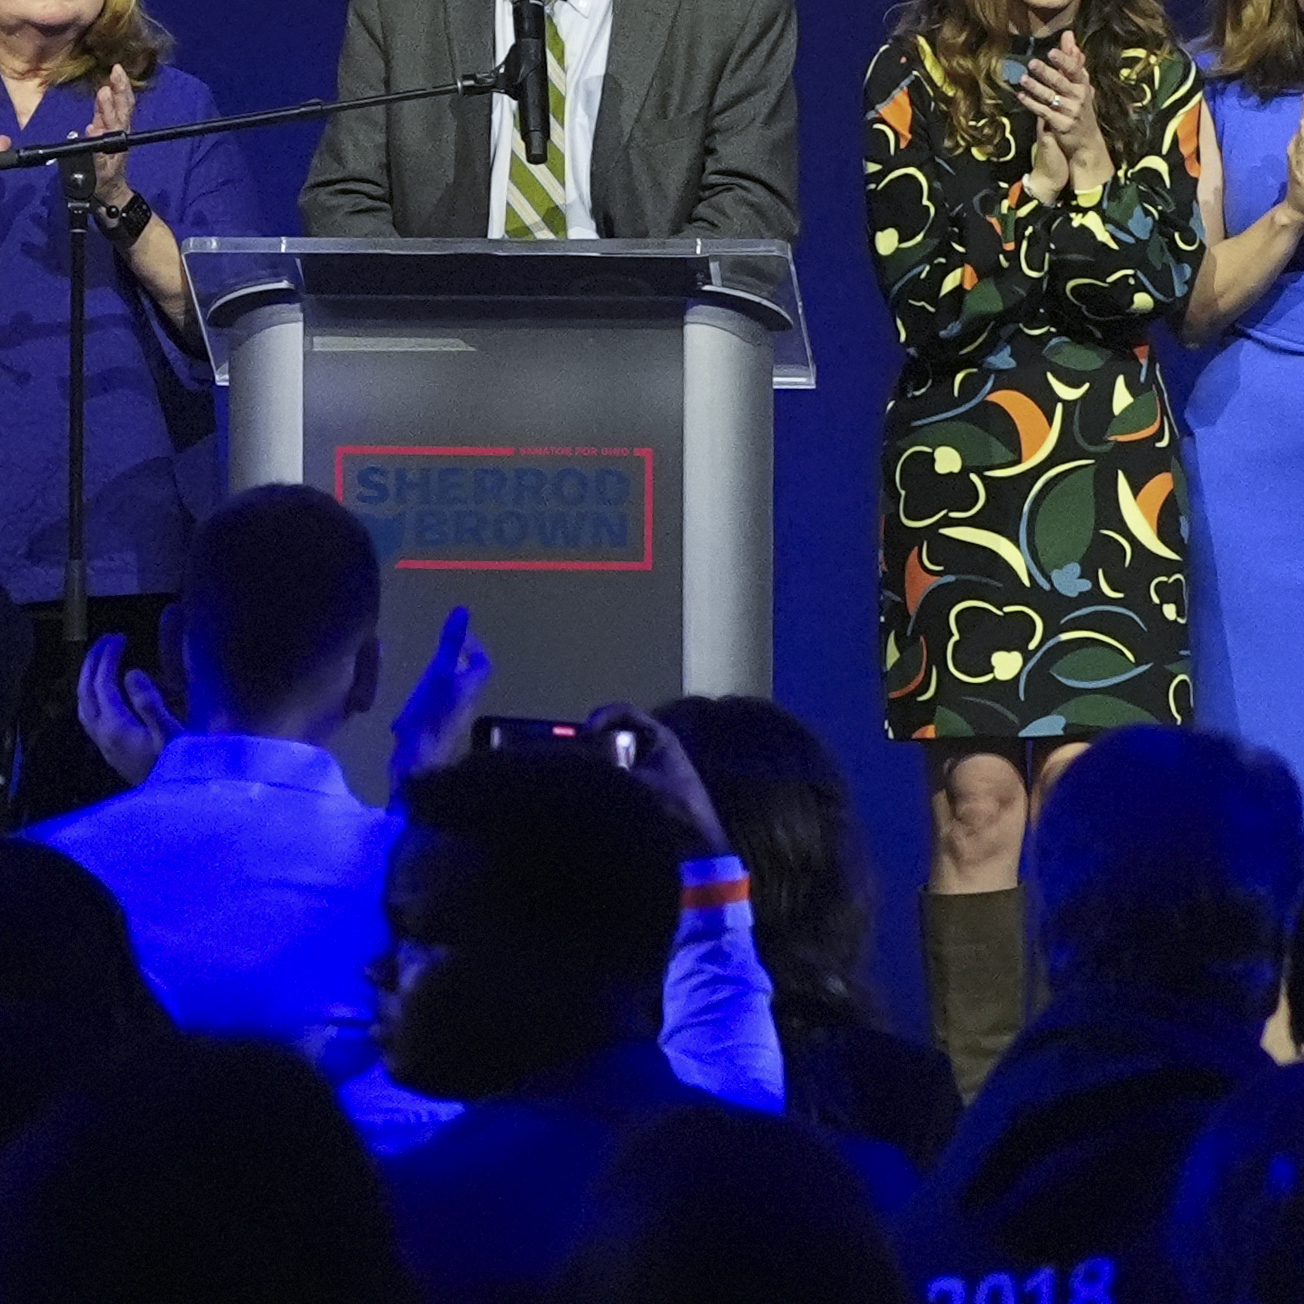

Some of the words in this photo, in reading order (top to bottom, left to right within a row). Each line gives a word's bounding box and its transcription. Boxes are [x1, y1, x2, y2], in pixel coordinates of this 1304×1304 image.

[575, 447, 598, 455] FOR
[356, 465, 632, 506] SHERROD
[414, 509, 629, 549] BROWN
